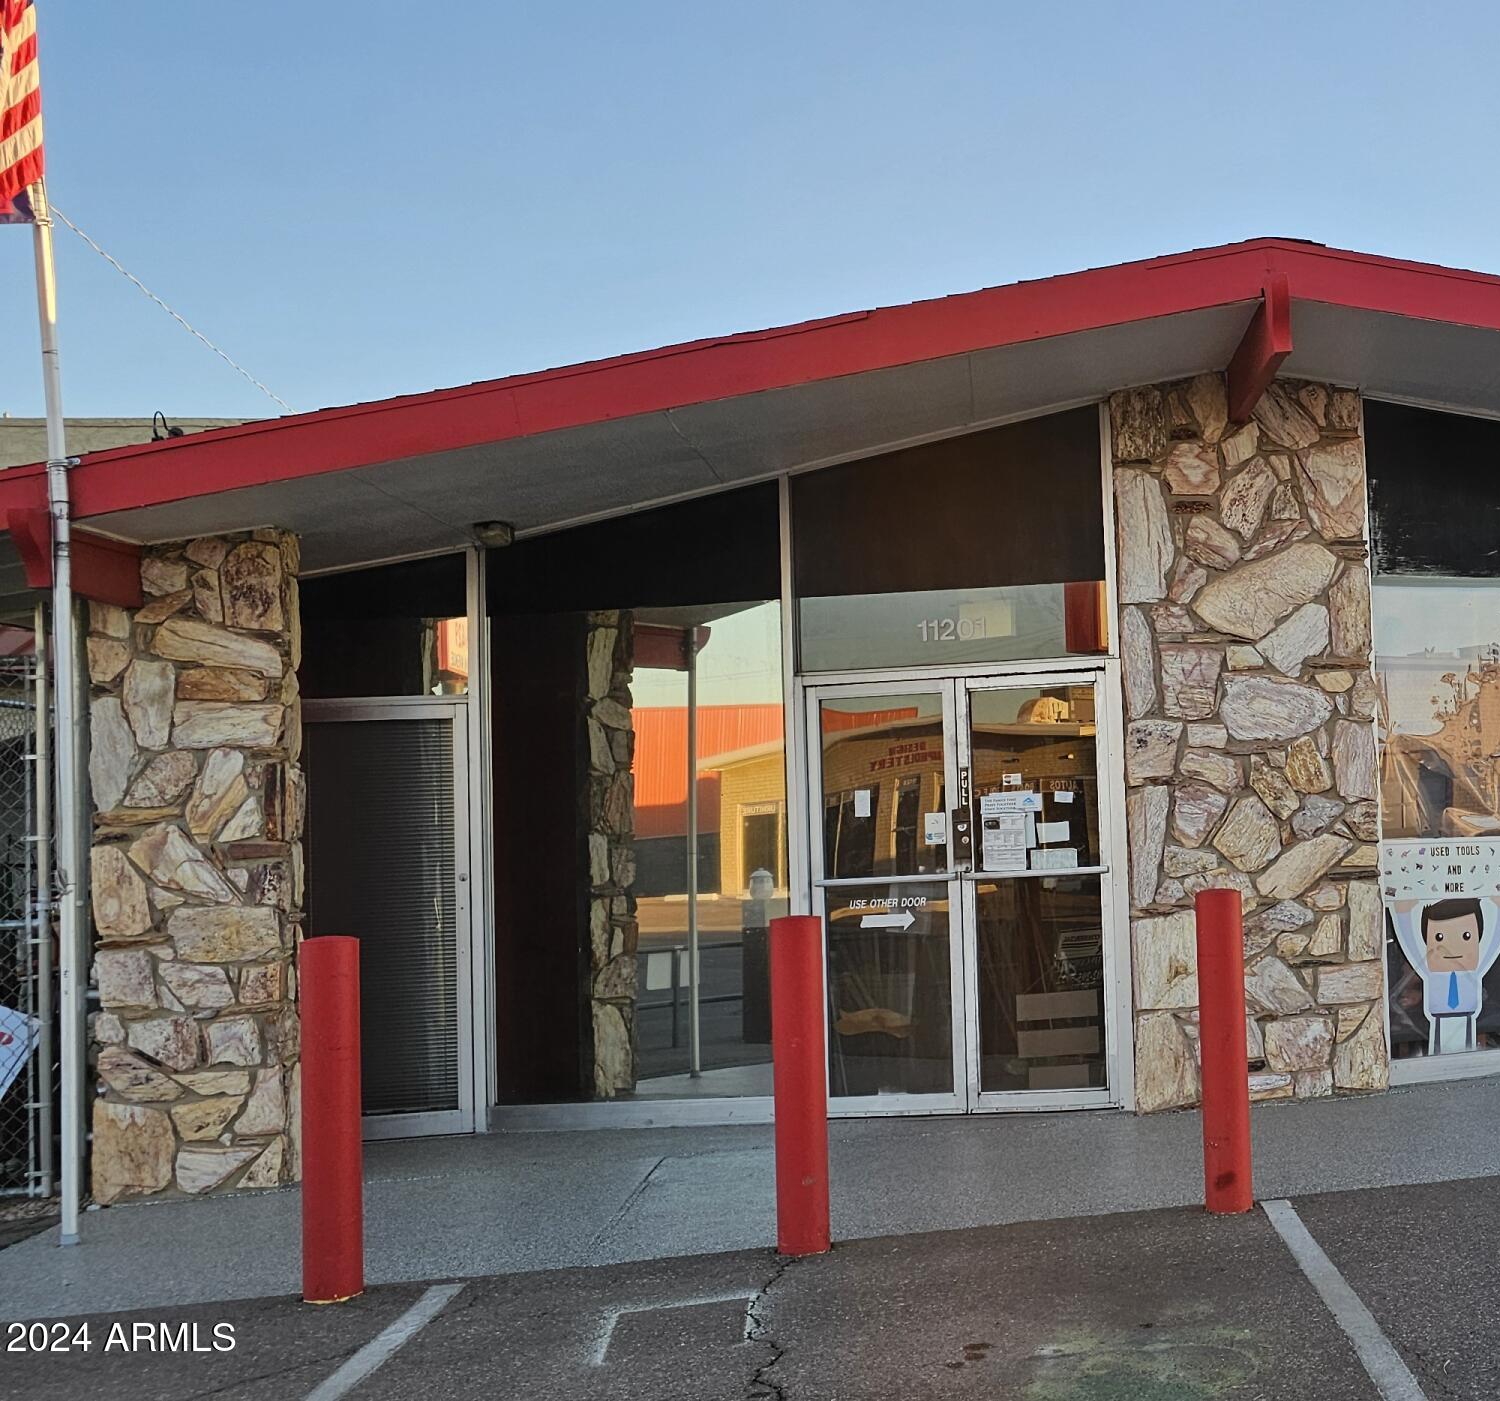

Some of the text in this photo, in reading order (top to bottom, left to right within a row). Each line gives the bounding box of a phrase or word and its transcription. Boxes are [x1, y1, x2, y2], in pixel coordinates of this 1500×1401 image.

[916, 618, 986, 641] 11201
[960, 771, 968, 806] PULL
[1430, 845, 1480, 857] USED TOOLS
[1447, 864, 1462, 875] AND
[1444, 882, 1464, 893] MORE
[849, 896, 927, 909] USE OTHER DOOR
